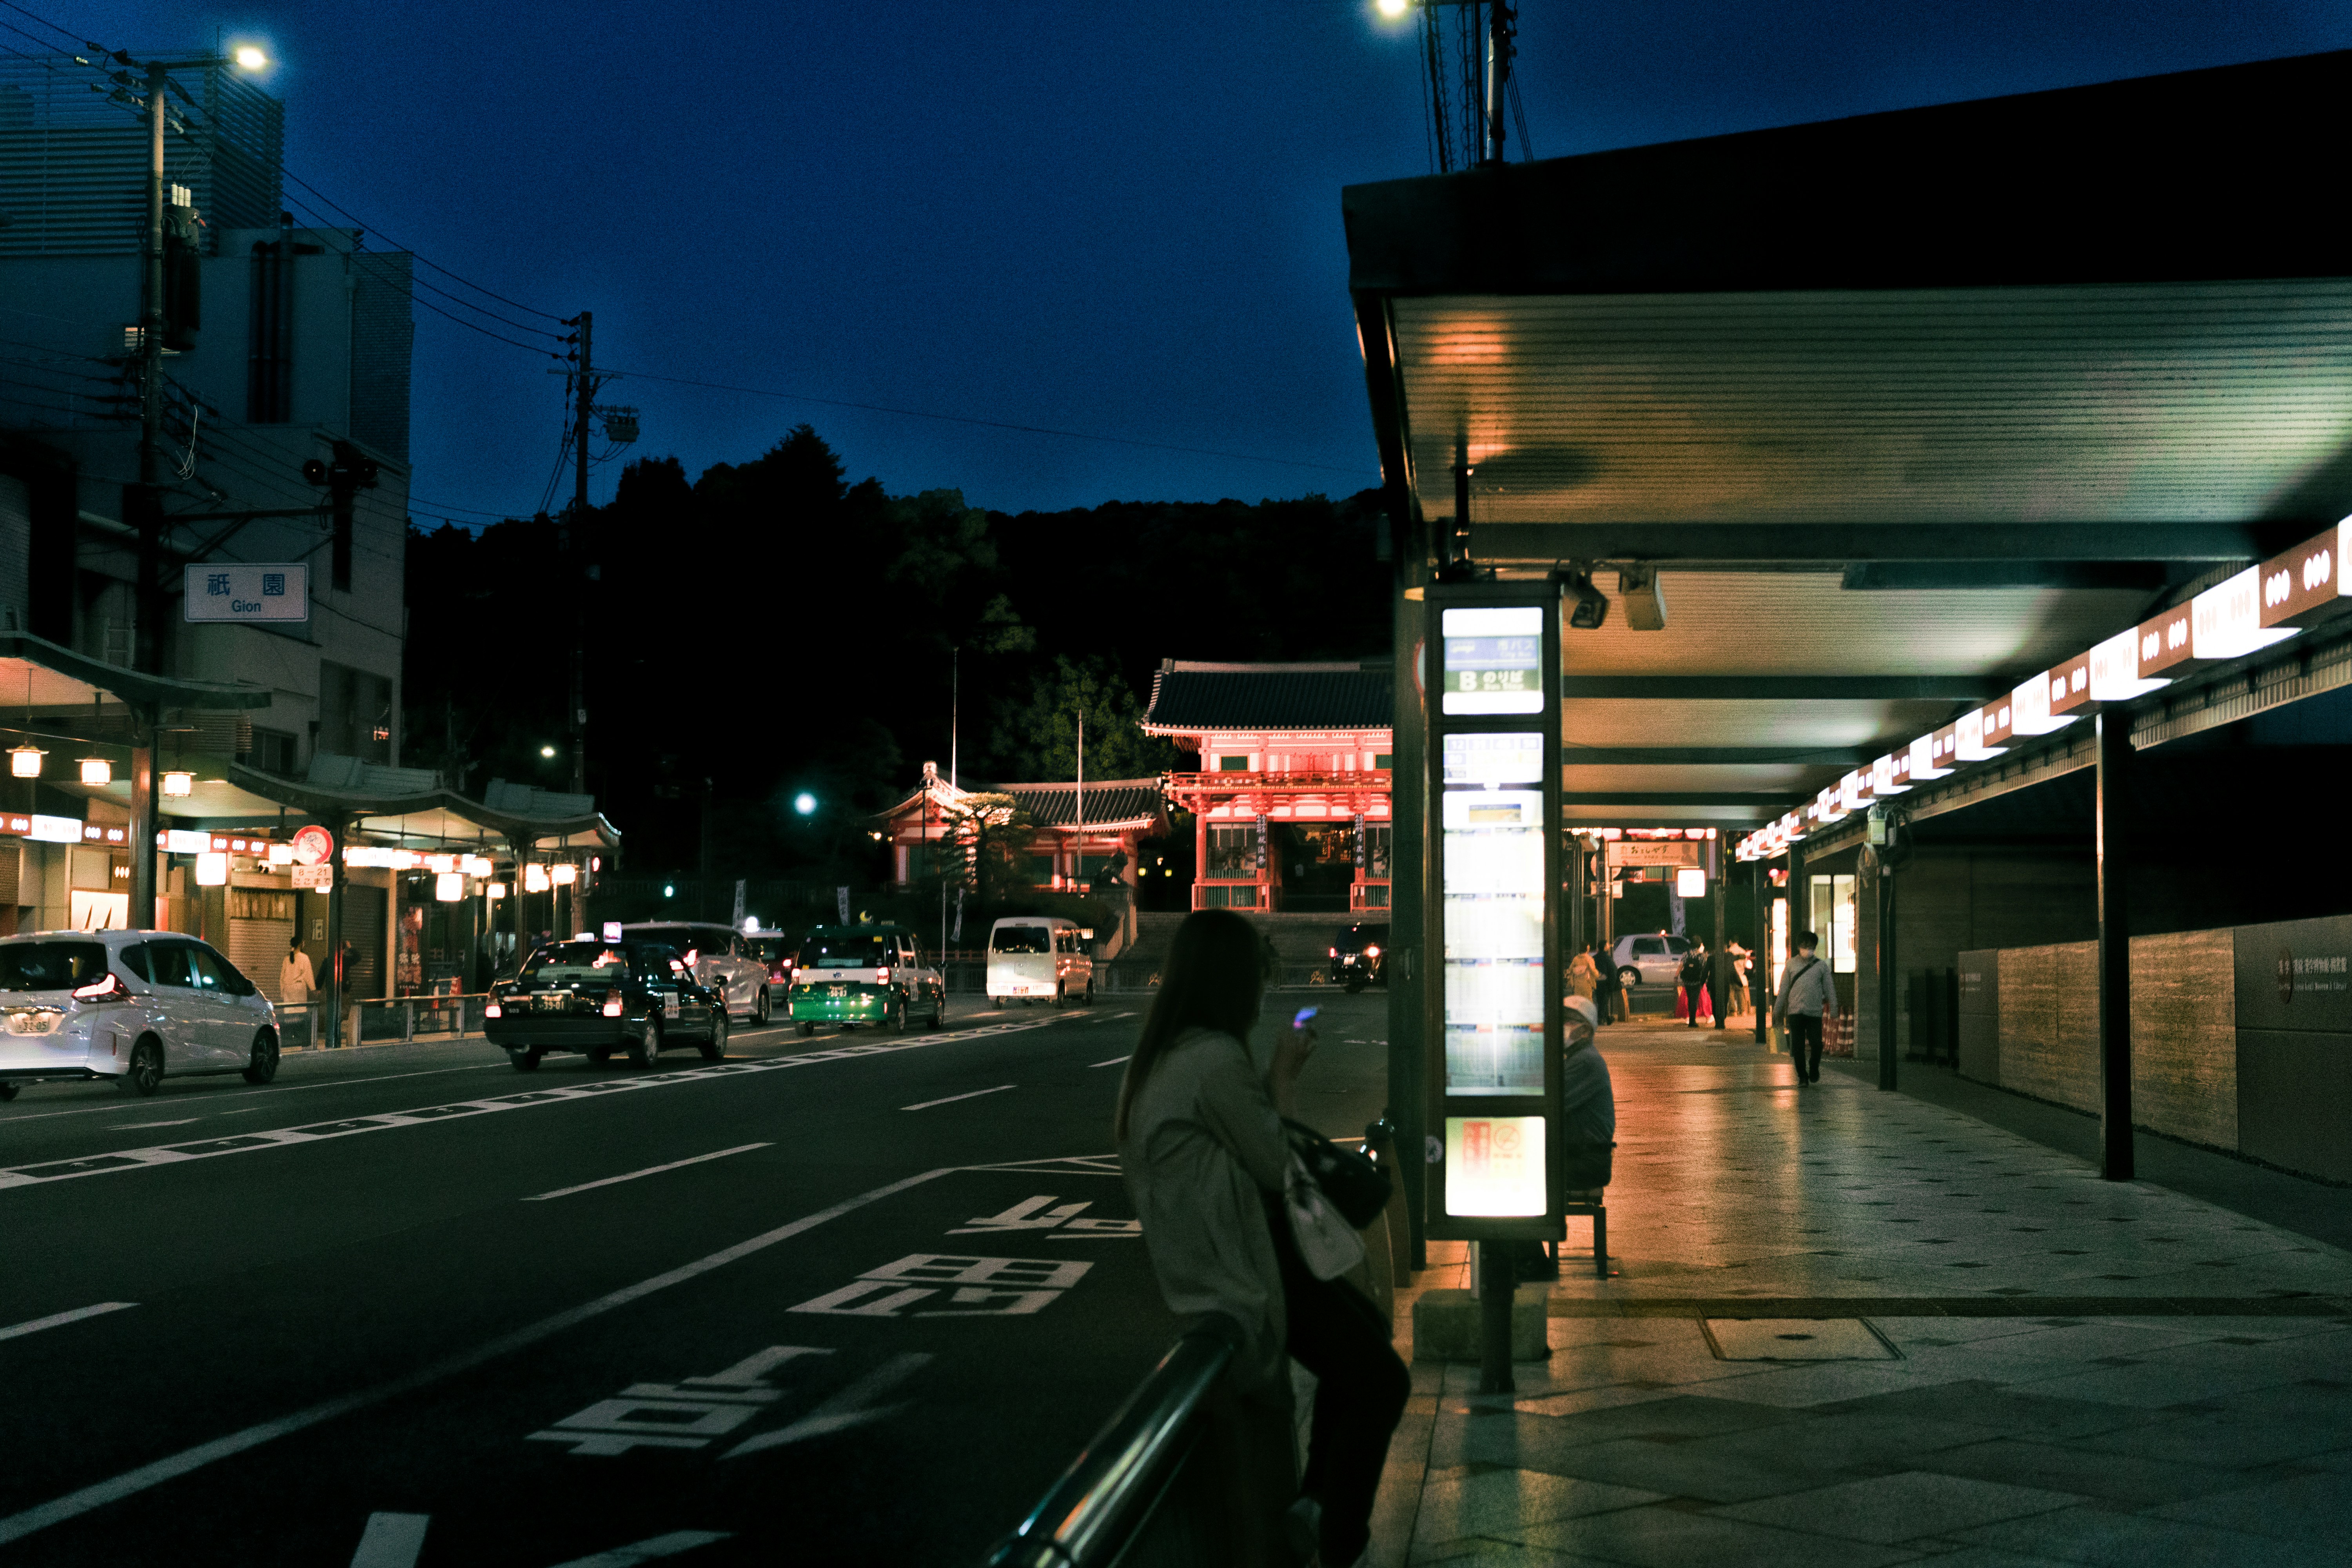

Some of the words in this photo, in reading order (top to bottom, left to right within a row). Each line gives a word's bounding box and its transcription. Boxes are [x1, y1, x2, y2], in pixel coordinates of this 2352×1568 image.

[207, 573, 285, 596] 祇園
[232, 600, 261, 612] Gion
[1459, 670, 1477, 691] B
[1483, 670, 1524, 684] のりば
[1451, 740, 1464, 749] 12
[294, 877, 331, 886] ここまで
[544, 1001, 564, 1010] 39-01
